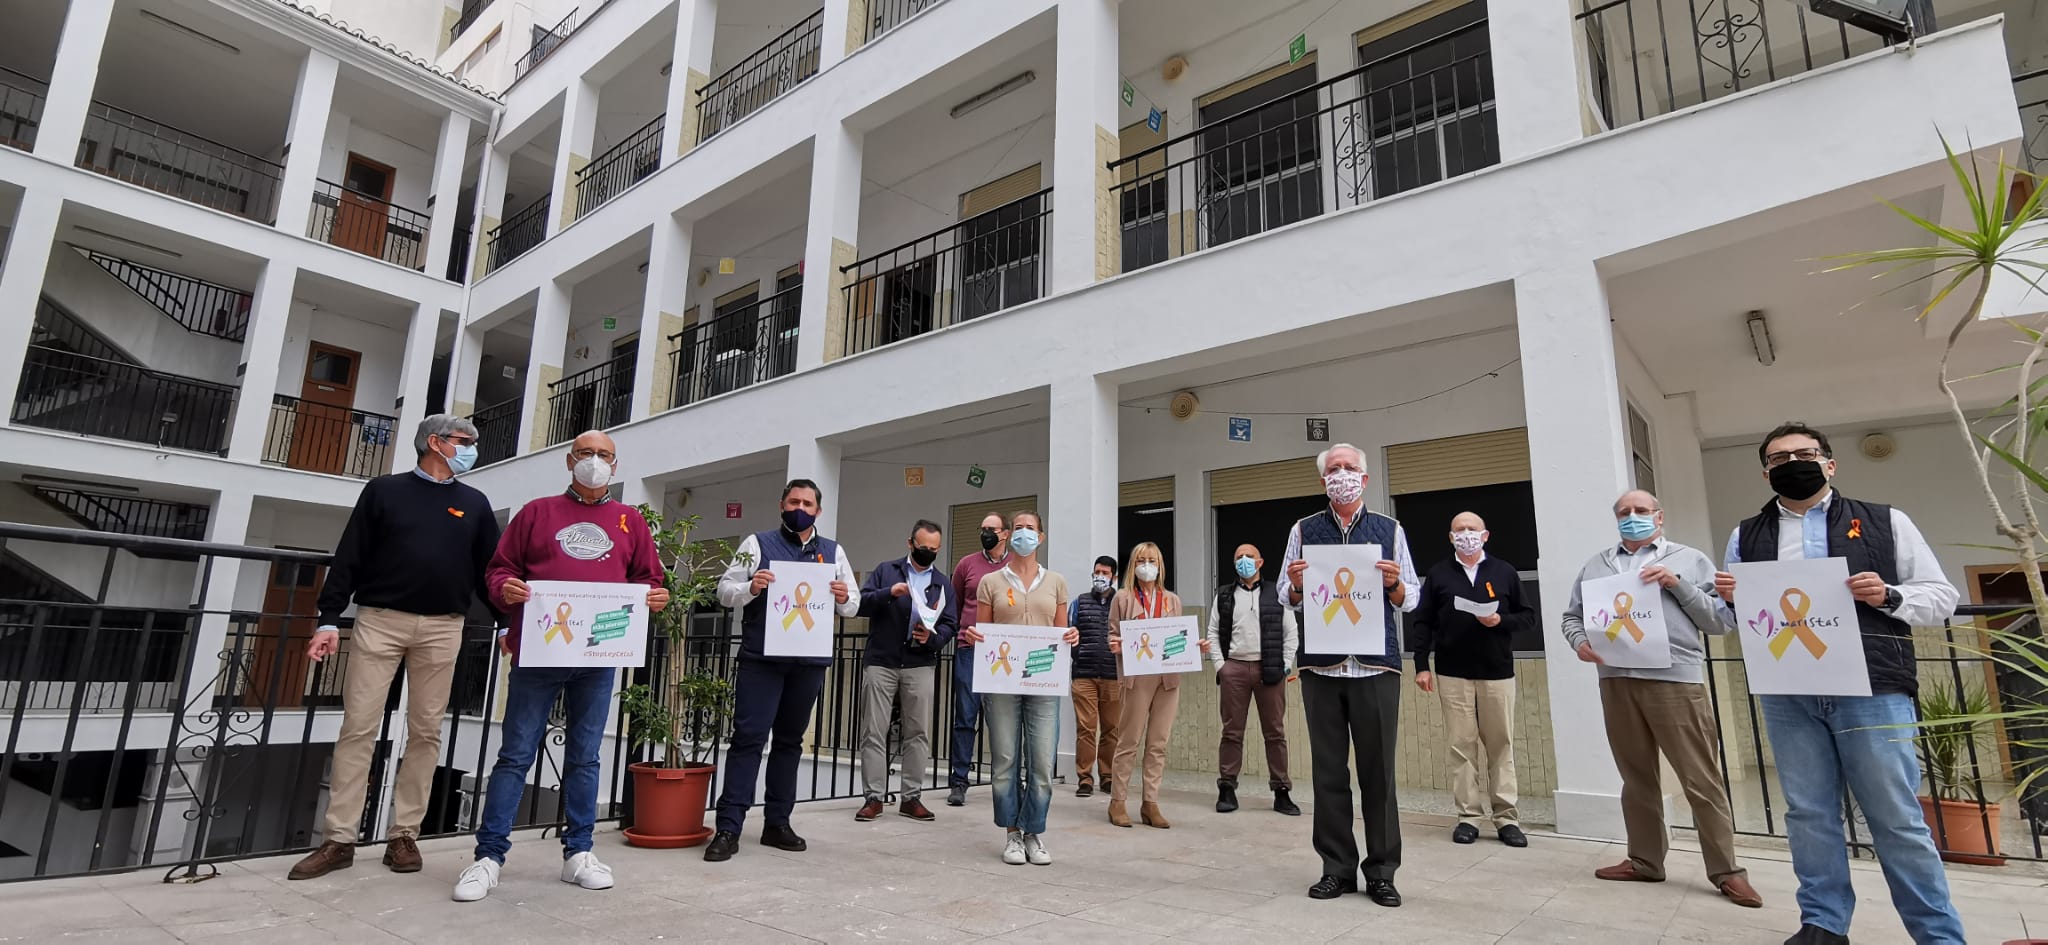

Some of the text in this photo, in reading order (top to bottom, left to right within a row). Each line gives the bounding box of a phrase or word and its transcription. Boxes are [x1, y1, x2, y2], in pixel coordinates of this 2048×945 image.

[1333, 592, 1371, 600] maristas
[792, 602, 825, 610] maristas
[1613, 611, 1651, 619] maristas
[1780, 616, 1839, 627] maristas
